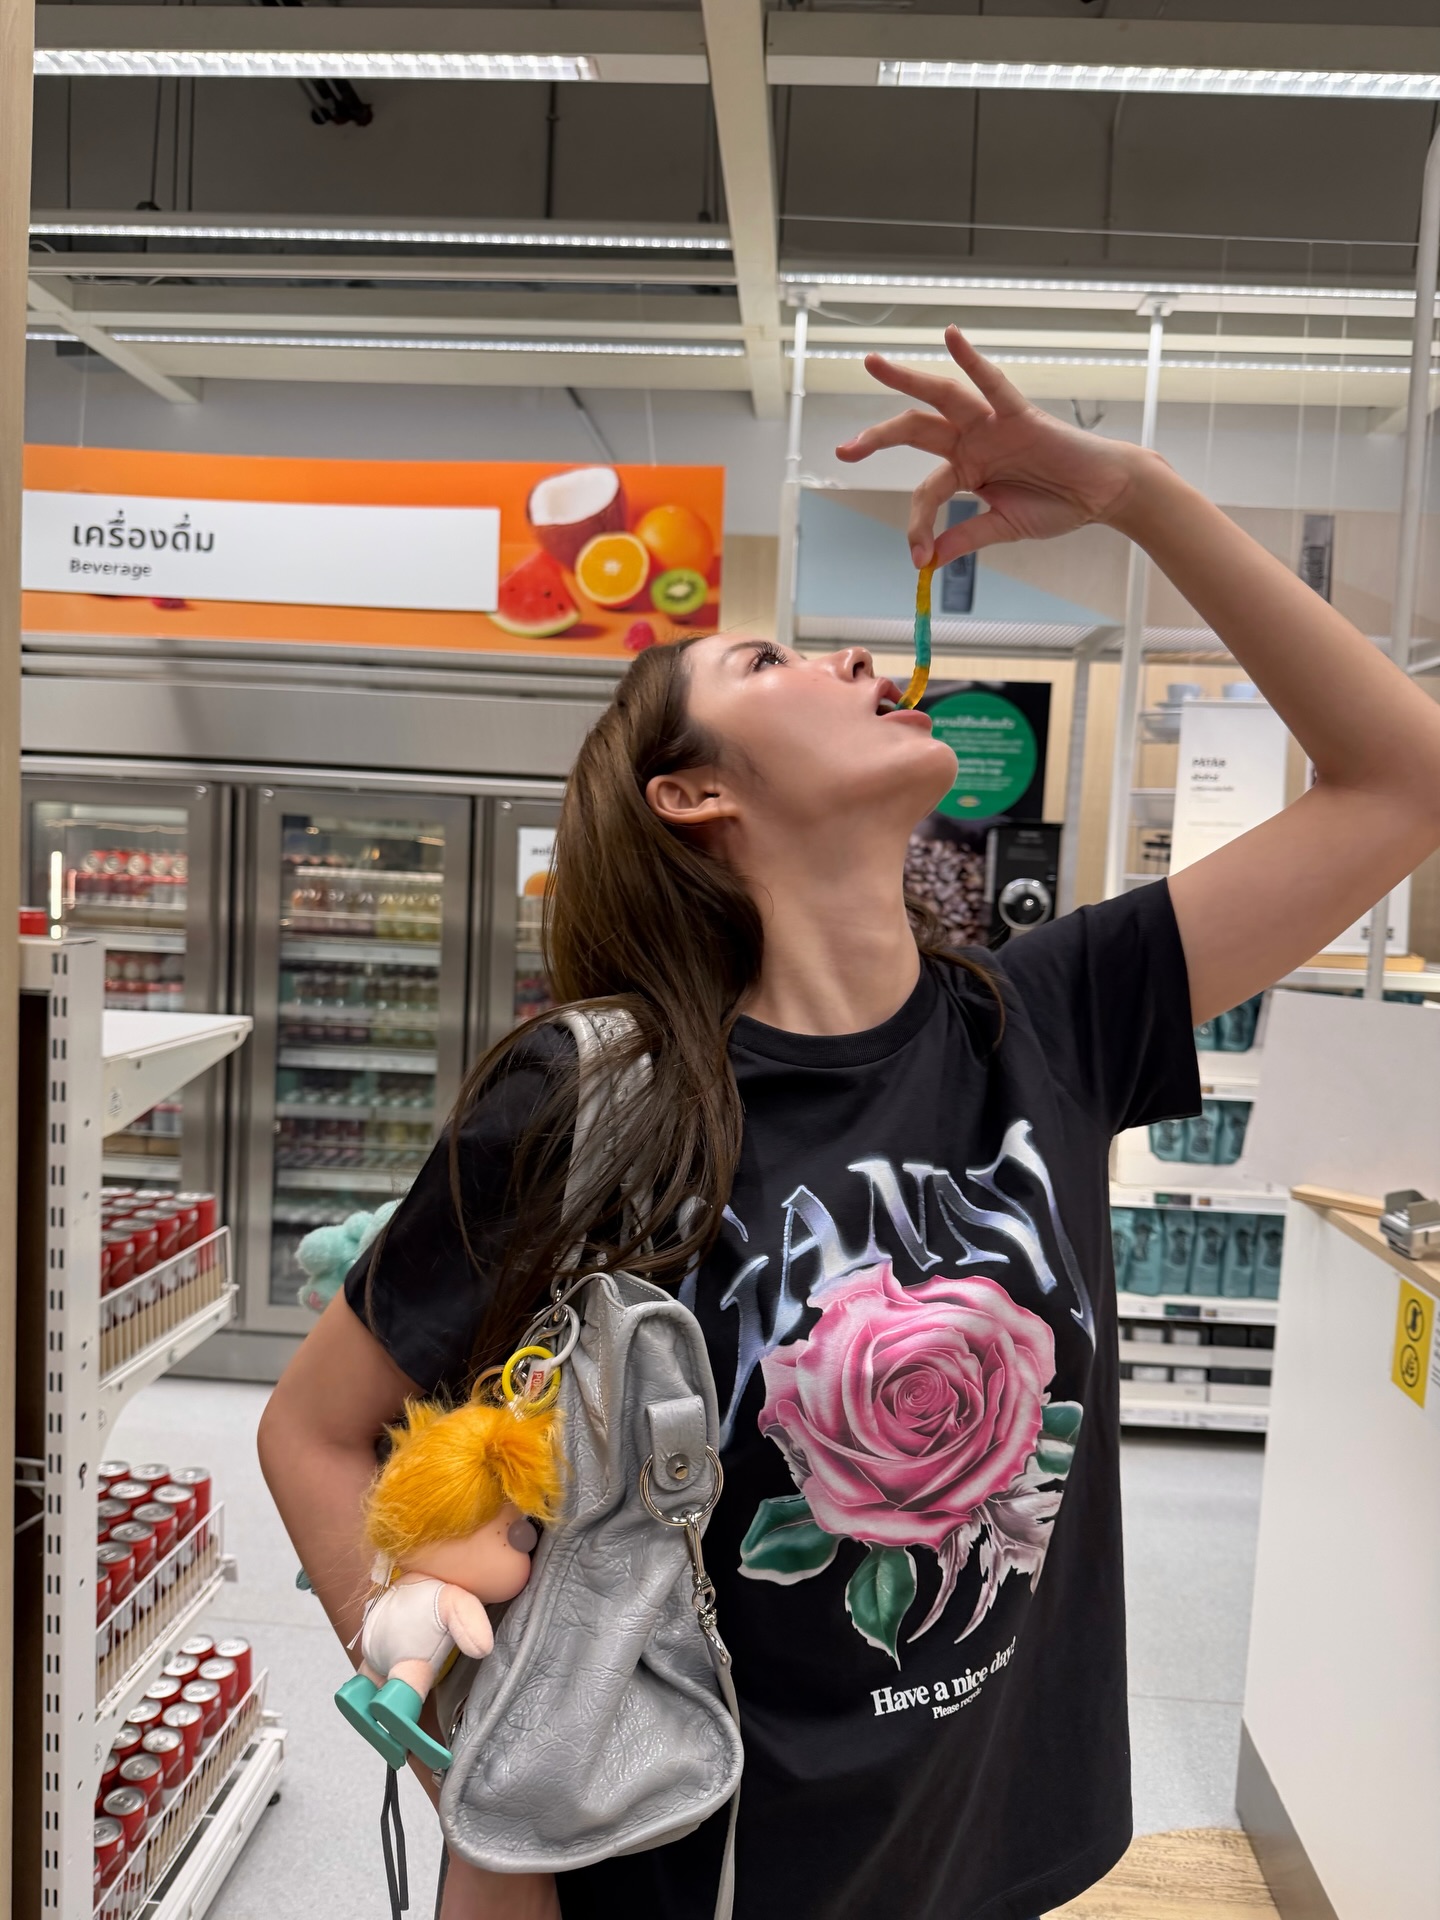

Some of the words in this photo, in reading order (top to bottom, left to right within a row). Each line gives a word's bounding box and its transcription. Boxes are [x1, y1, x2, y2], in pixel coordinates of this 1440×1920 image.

[73, 508, 214, 553] เครื่องดื่ม
[69, 559, 152, 581] Beverage
[870, 1685, 930, 1716] Have
[933, 1681, 950, 1702] a
[951, 1667, 989, 1698] nice
[990, 1635, 1017, 1674] day!
[932, 1702, 960, 1719] Please
